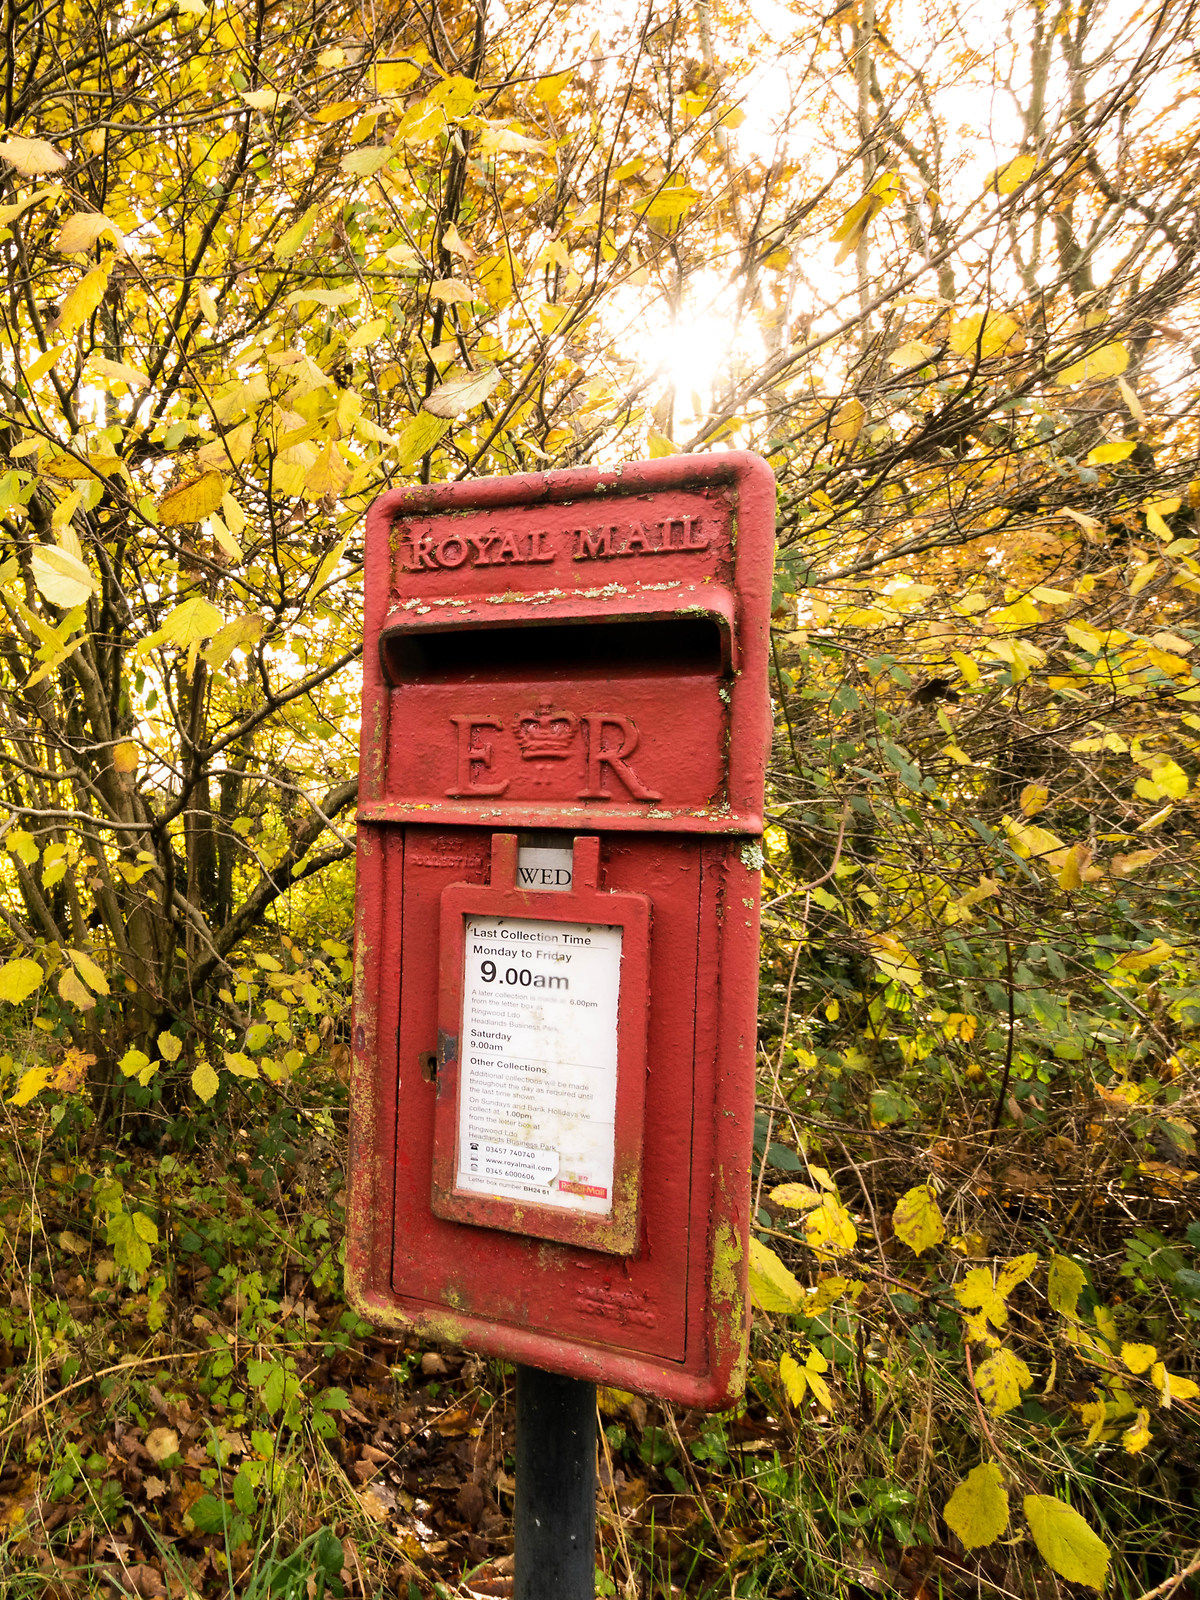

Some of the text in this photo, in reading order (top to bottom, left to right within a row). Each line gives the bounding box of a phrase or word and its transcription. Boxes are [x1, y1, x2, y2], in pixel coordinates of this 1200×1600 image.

[404, 516, 710, 573] ROYAL MAIL
[445, 711, 663, 802] E R
[518, 867, 572, 885] WED
[473, 928, 591, 945] Last Collection Time
[473, 945, 572, 963] Monday to Friday
[480, 960, 569, 990] 9.00am
[478, 989, 493, 997] later
[495, 991, 528, 1001] collection
[569, 1000, 598, 1008] 6.00pm
[502, 1000, 518, 1008] letter
[471, 1008, 506, 1018] Ringwood
[471, 1018, 507, 1028] Headlands
[509, 1020, 540, 1030] Business
[471, 1029, 511, 1041] Saturday
[470, 1041, 503, 1051] 9.00am
[470, 1057, 547, 1074] Other Collections
[470, 1069, 503, 1079] Additional
[505, 1073, 542, 1084] collections
[557, 1079, 567, 1087] be
[568, 1081, 589, 1090] made
[469, 1086, 480, 1094] the
[482, 1087, 494, 1095] last
[495, 1089, 511, 1097] time
[470, 1077, 506, 1089] throughout
[521, 1083, 534, 1093] day
[546, 1088, 575, 1098] required
[577, 1091, 593, 1100] until
[469, 1105, 491, 1113] collect
[506, 1110, 532, 1120] 1.00pm
[481, 1097, 510, 1108] Sundays
[512, 1102, 525, 1110] and
[527, 1104, 545, 1112] Bank
[547, 1107, 578, 1118] Holidays
[469, 1113, 484, 1121] from
[499, 1118, 516, 1127] letter
[469, 1124, 503, 1135] Ringwood
[469, 1132, 556, 1151] Headlands Business Park
[485, 1145, 536, 1159] 03457 740740
[485, 1157, 552, 1172] www.royalmail.com
[485, 1167, 535, 1181] 0345 6000606
[468, 1176, 484, 1185] Letter
[486, 1179, 498, 1187] box
[523, 1185, 540, 1195] BH24
[587, 1185, 606, 1197] Mail
